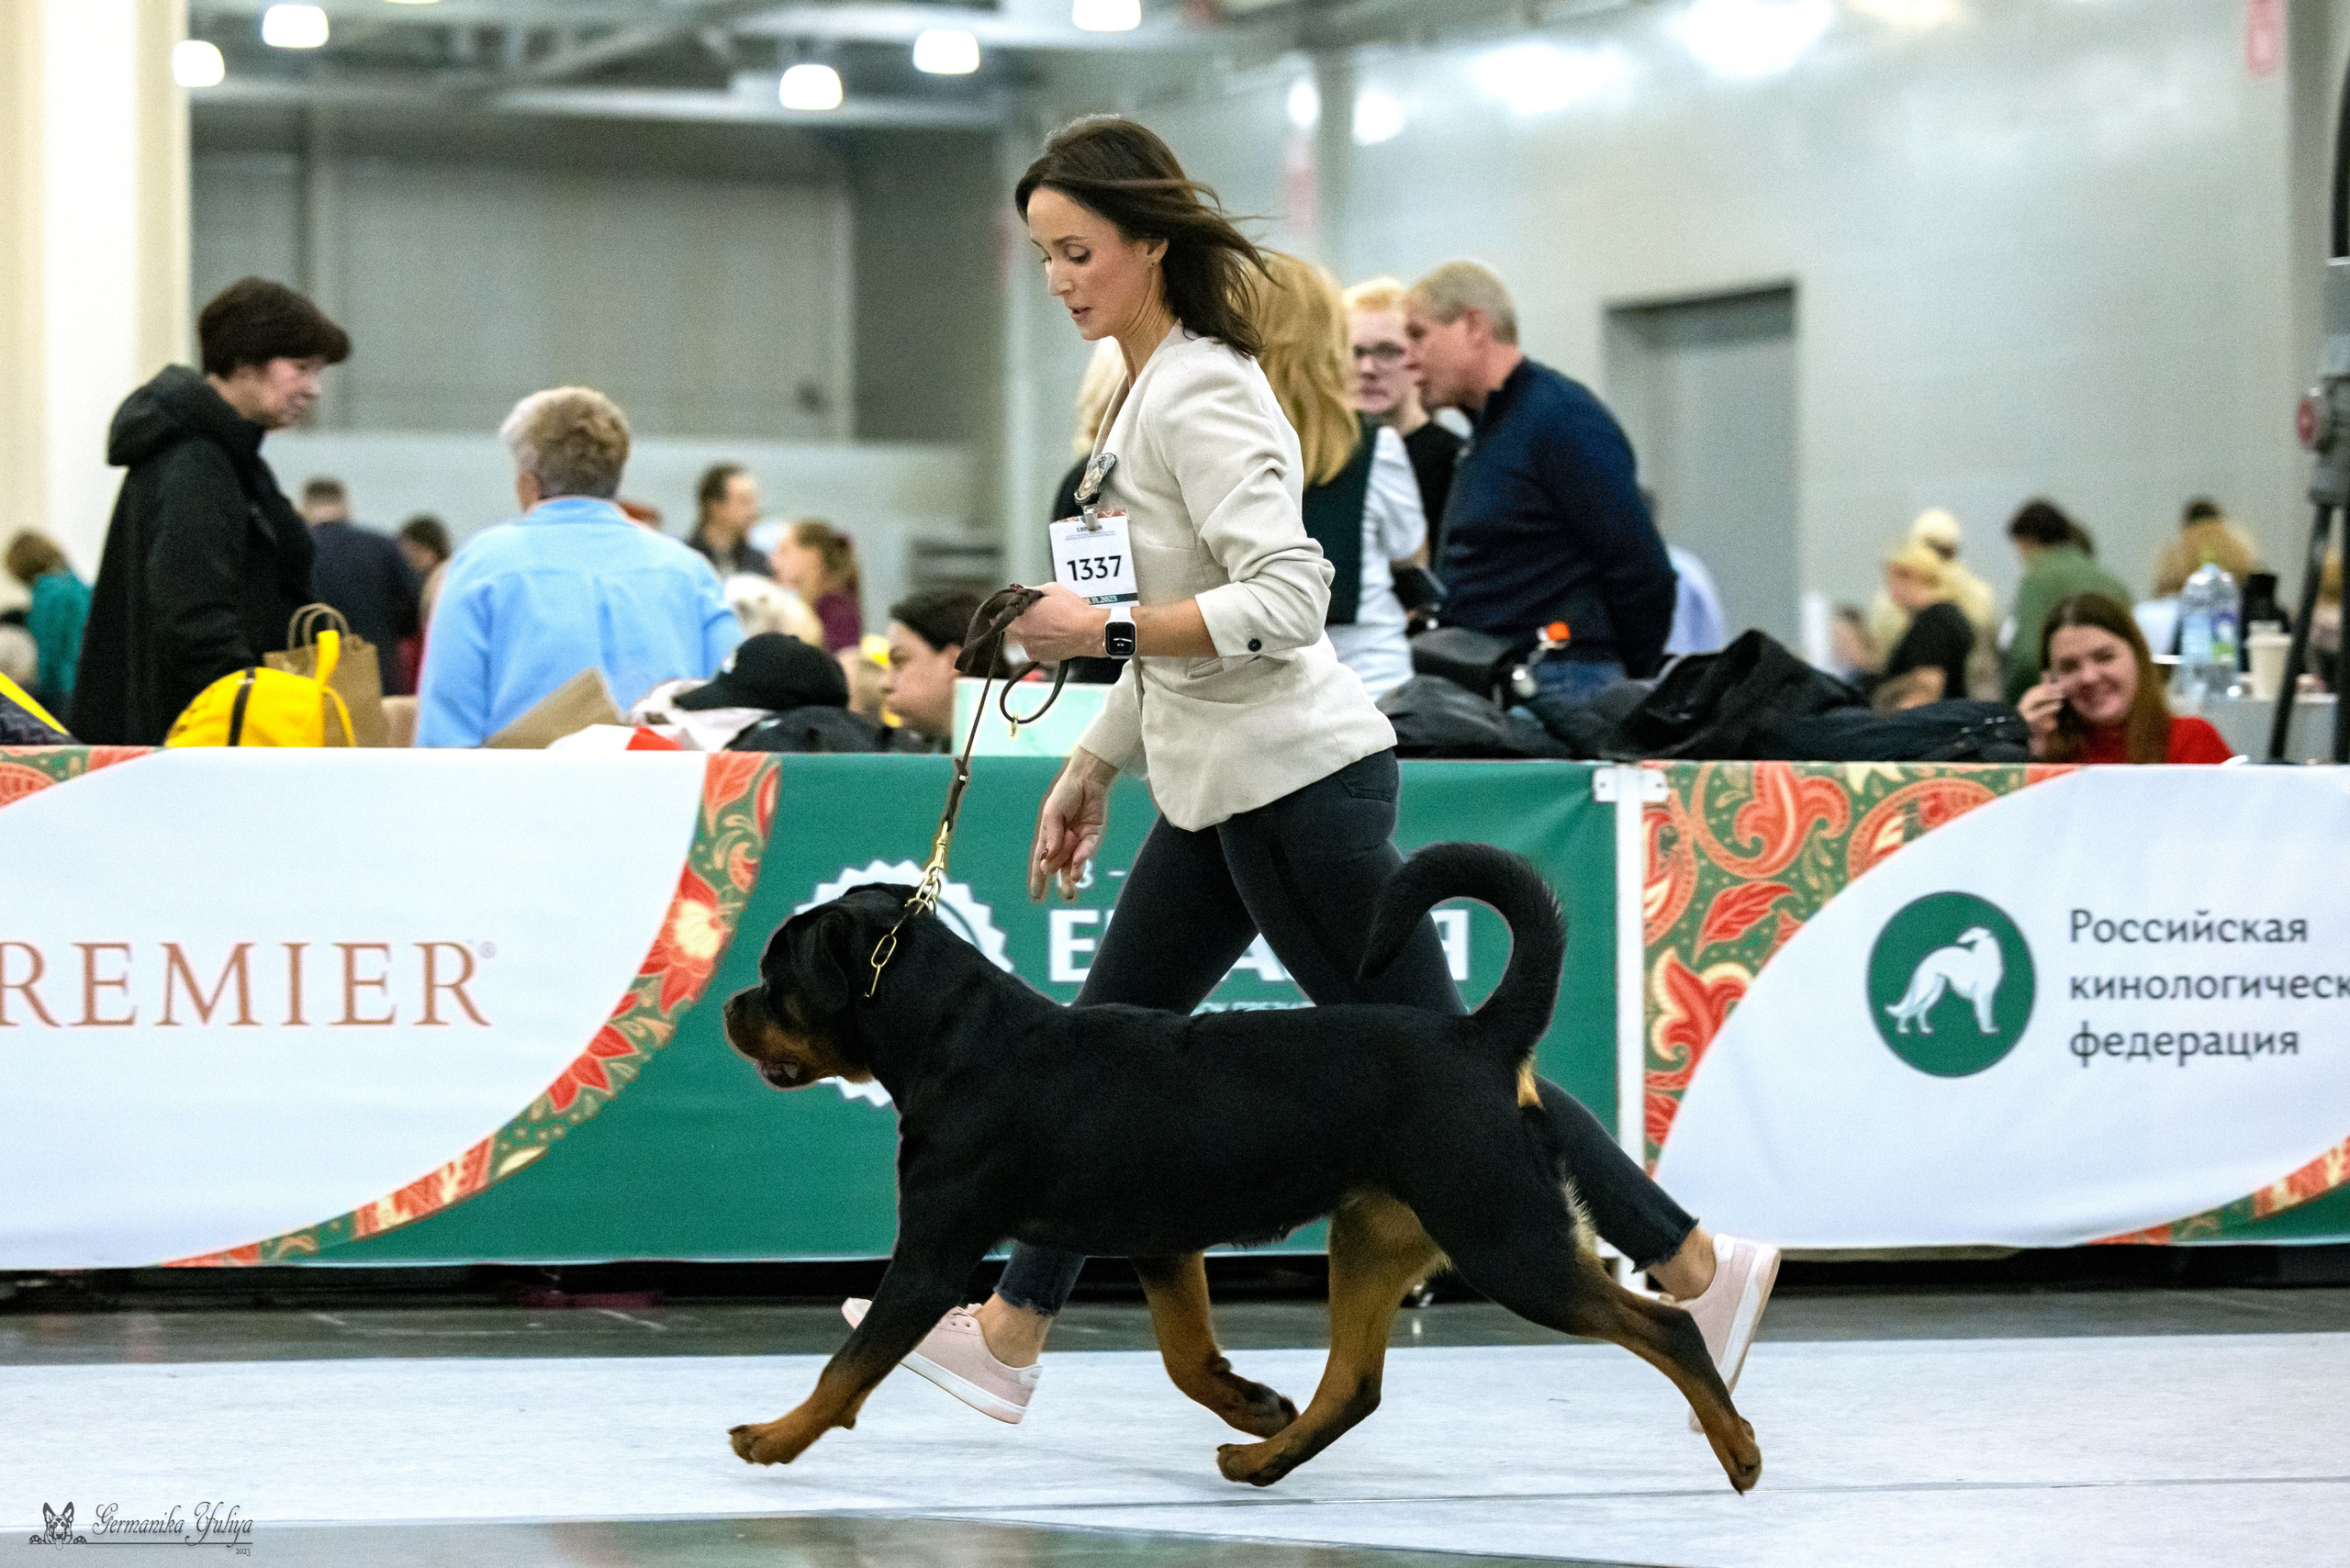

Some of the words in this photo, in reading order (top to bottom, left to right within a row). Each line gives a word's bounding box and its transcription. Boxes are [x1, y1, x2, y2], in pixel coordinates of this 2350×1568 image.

[1067, 554, 1122, 581] 1337
[2070, 908, 2308, 943] Российская
[2070, 1020, 2299, 1068] федерация
